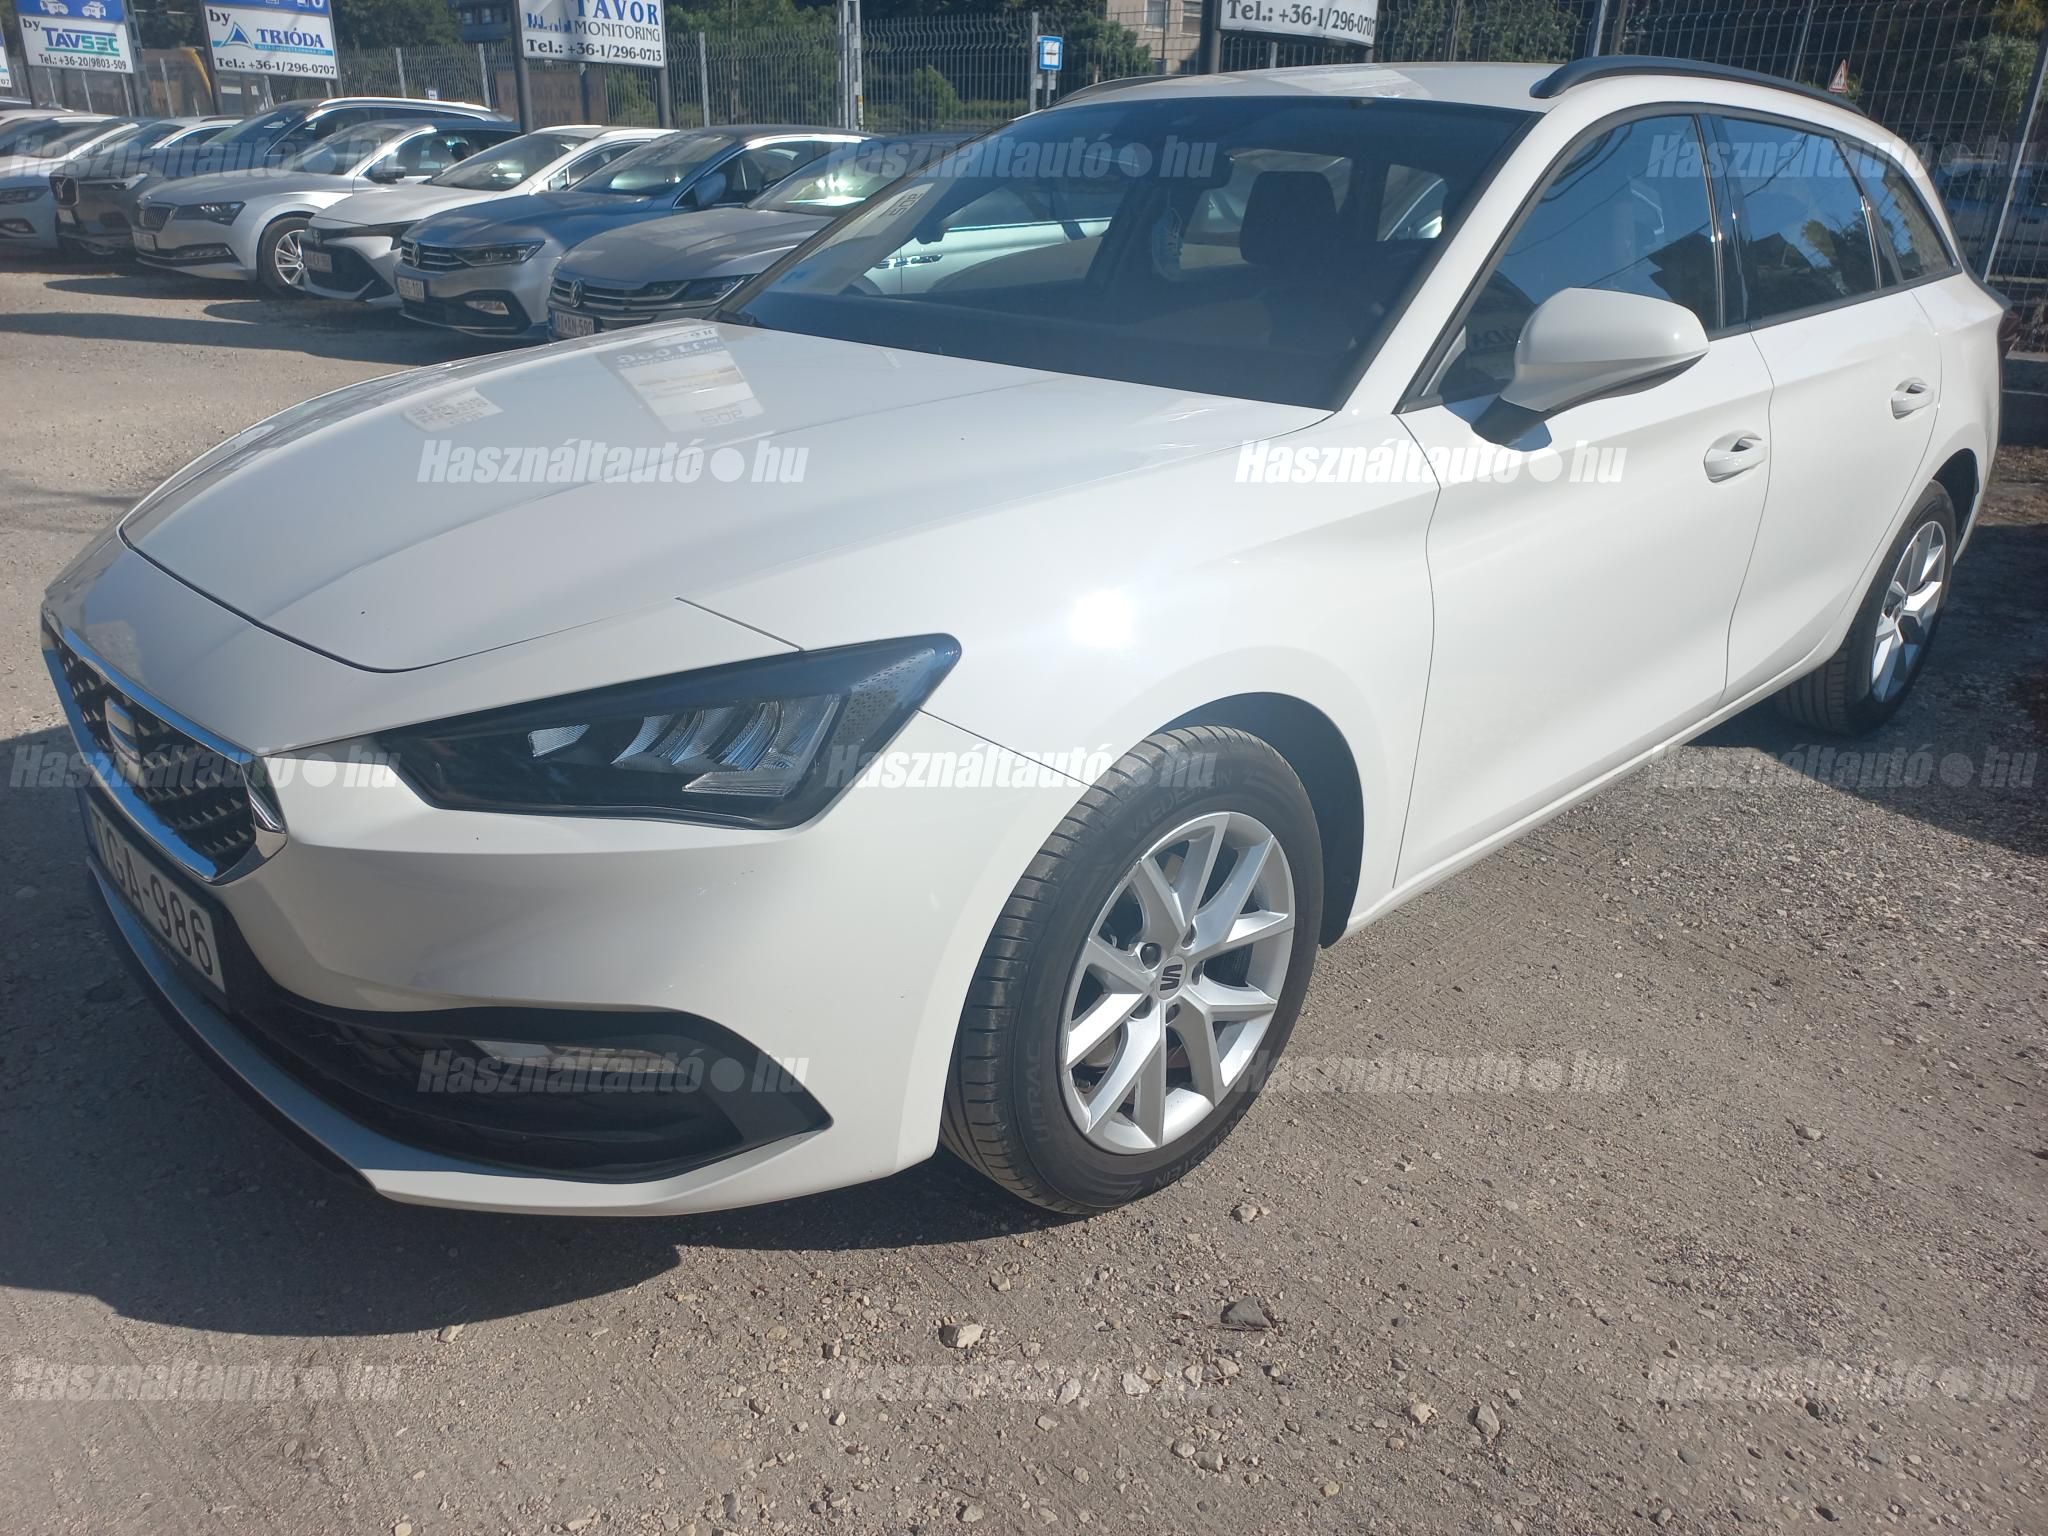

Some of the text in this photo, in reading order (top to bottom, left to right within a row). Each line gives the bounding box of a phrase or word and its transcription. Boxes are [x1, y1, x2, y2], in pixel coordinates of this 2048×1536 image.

[208, 9, 231, 26] by
[577, 0, 660, 26] TAVOR
[1227, 0, 1376, 37] Tel.: +36-1/296-0707
[22, 17, 41, 31] by
[574, 21, 661, 42] MONITORING
[256, 27, 325, 48] TRIÓDA
[38, 53, 58, 65] Tel.:
[526, 38, 662, 62] Tel.: +36-1/296-0713
[216, 57, 336, 75] Tel.: +36-1/296-0707
